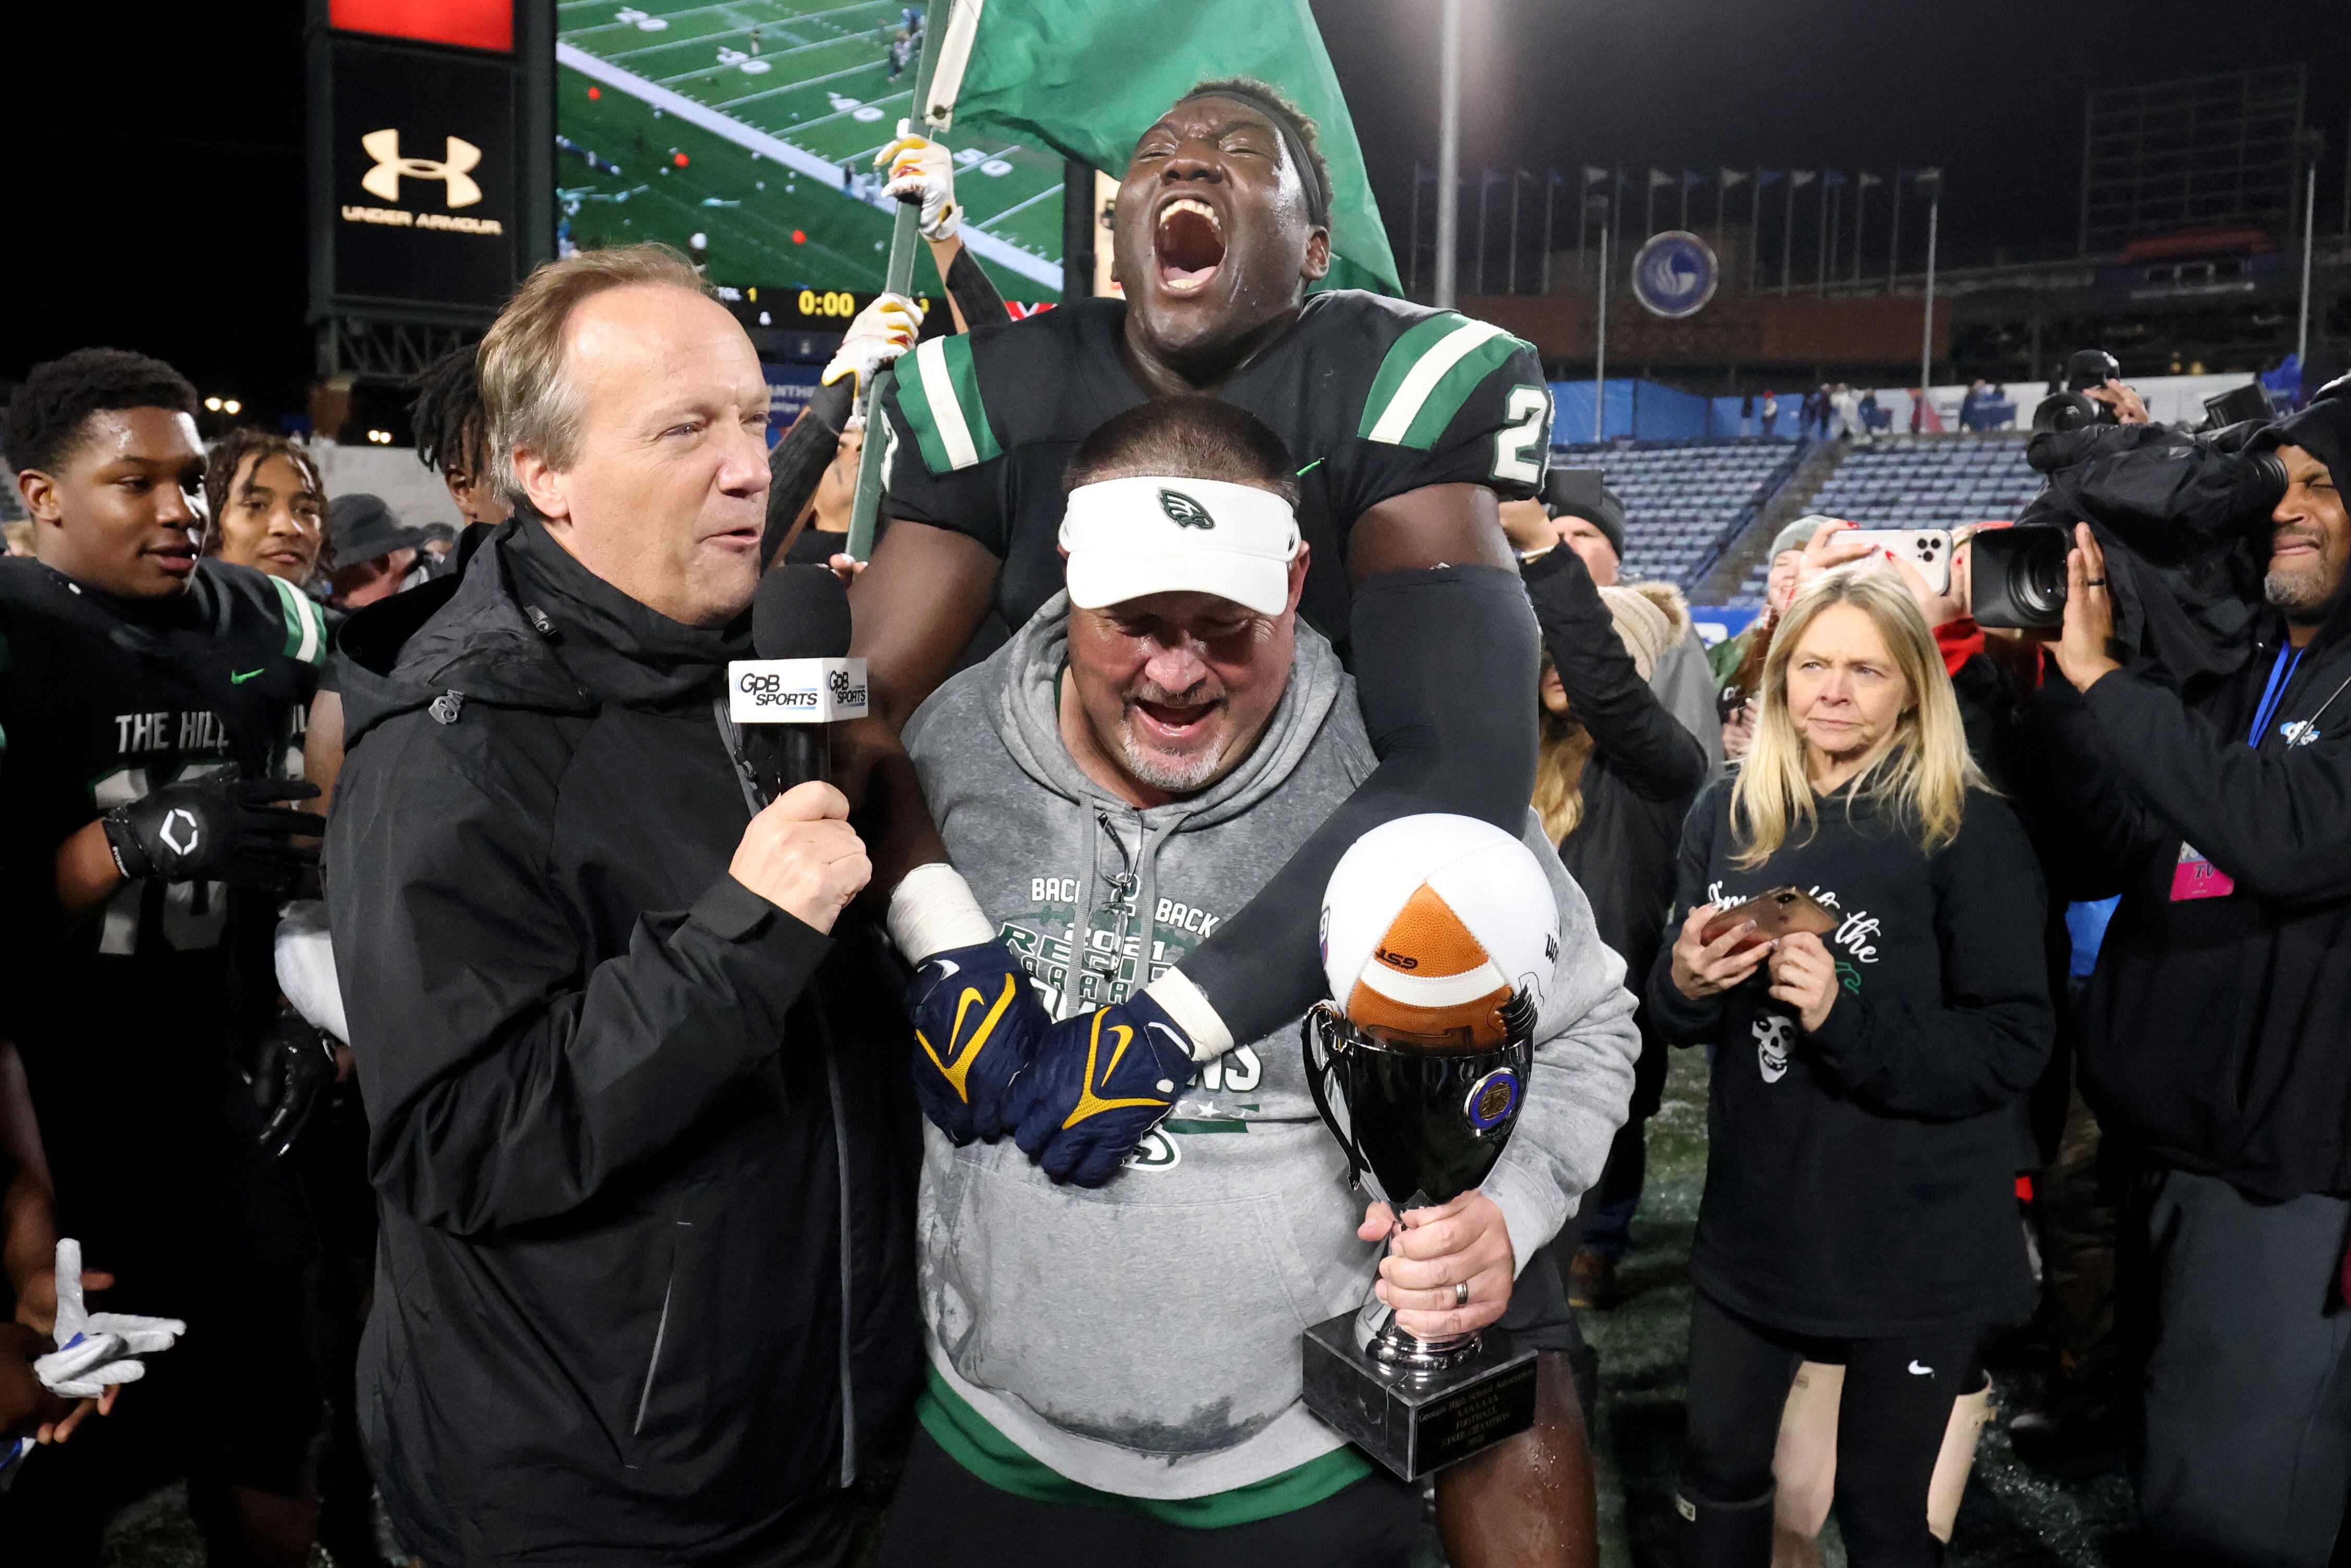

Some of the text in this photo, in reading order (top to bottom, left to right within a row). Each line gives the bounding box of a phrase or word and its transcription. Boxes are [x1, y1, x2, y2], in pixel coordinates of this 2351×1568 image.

[342, 205, 503, 235] UNDER ARMOUR
[798, 290, 855, 318] 0:00
[1490, 384, 1556, 495] 2
[740, 673, 780, 695] GPB
[829, 669, 849, 694] GPB
[756, 693, 818, 706] SPORTS
[837, 690, 866, 704] SPORTS
[115, 712, 170, 753] THE
[1154, 897, 1221, 939] BACK
[1834, 911, 1882, 963] the
[1374, 949, 1418, 969] GST
